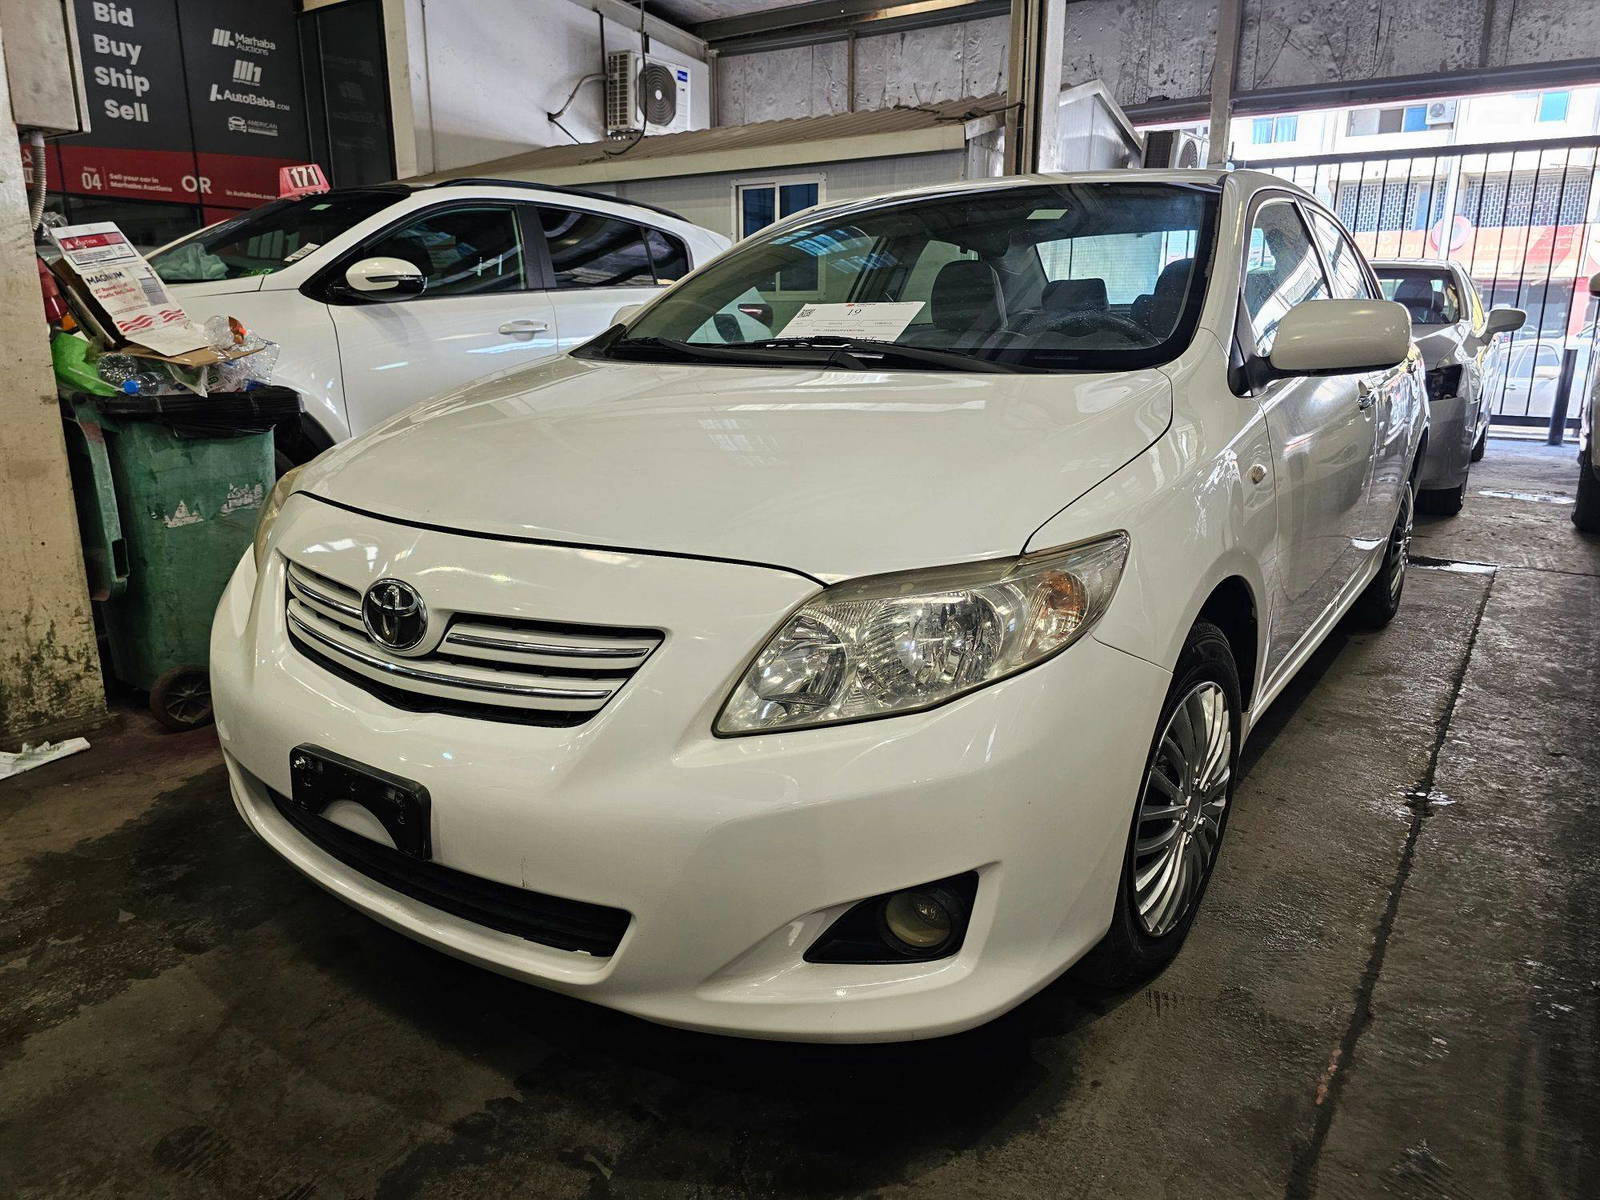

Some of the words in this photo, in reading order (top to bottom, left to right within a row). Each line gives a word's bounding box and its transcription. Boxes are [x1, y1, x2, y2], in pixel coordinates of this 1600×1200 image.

[93, 1, 134, 28] Bid
[93, 33, 142, 66] Buy
[235, 32, 277, 51] Marhaba
[236, 42, 269, 56] Auctions
[94, 66, 150, 97] Ship
[104, 98, 149, 122] Sell
[81, 172, 102, 190] 04
[181, 175, 212, 194] OR
[290, 166, 320, 187] 171
